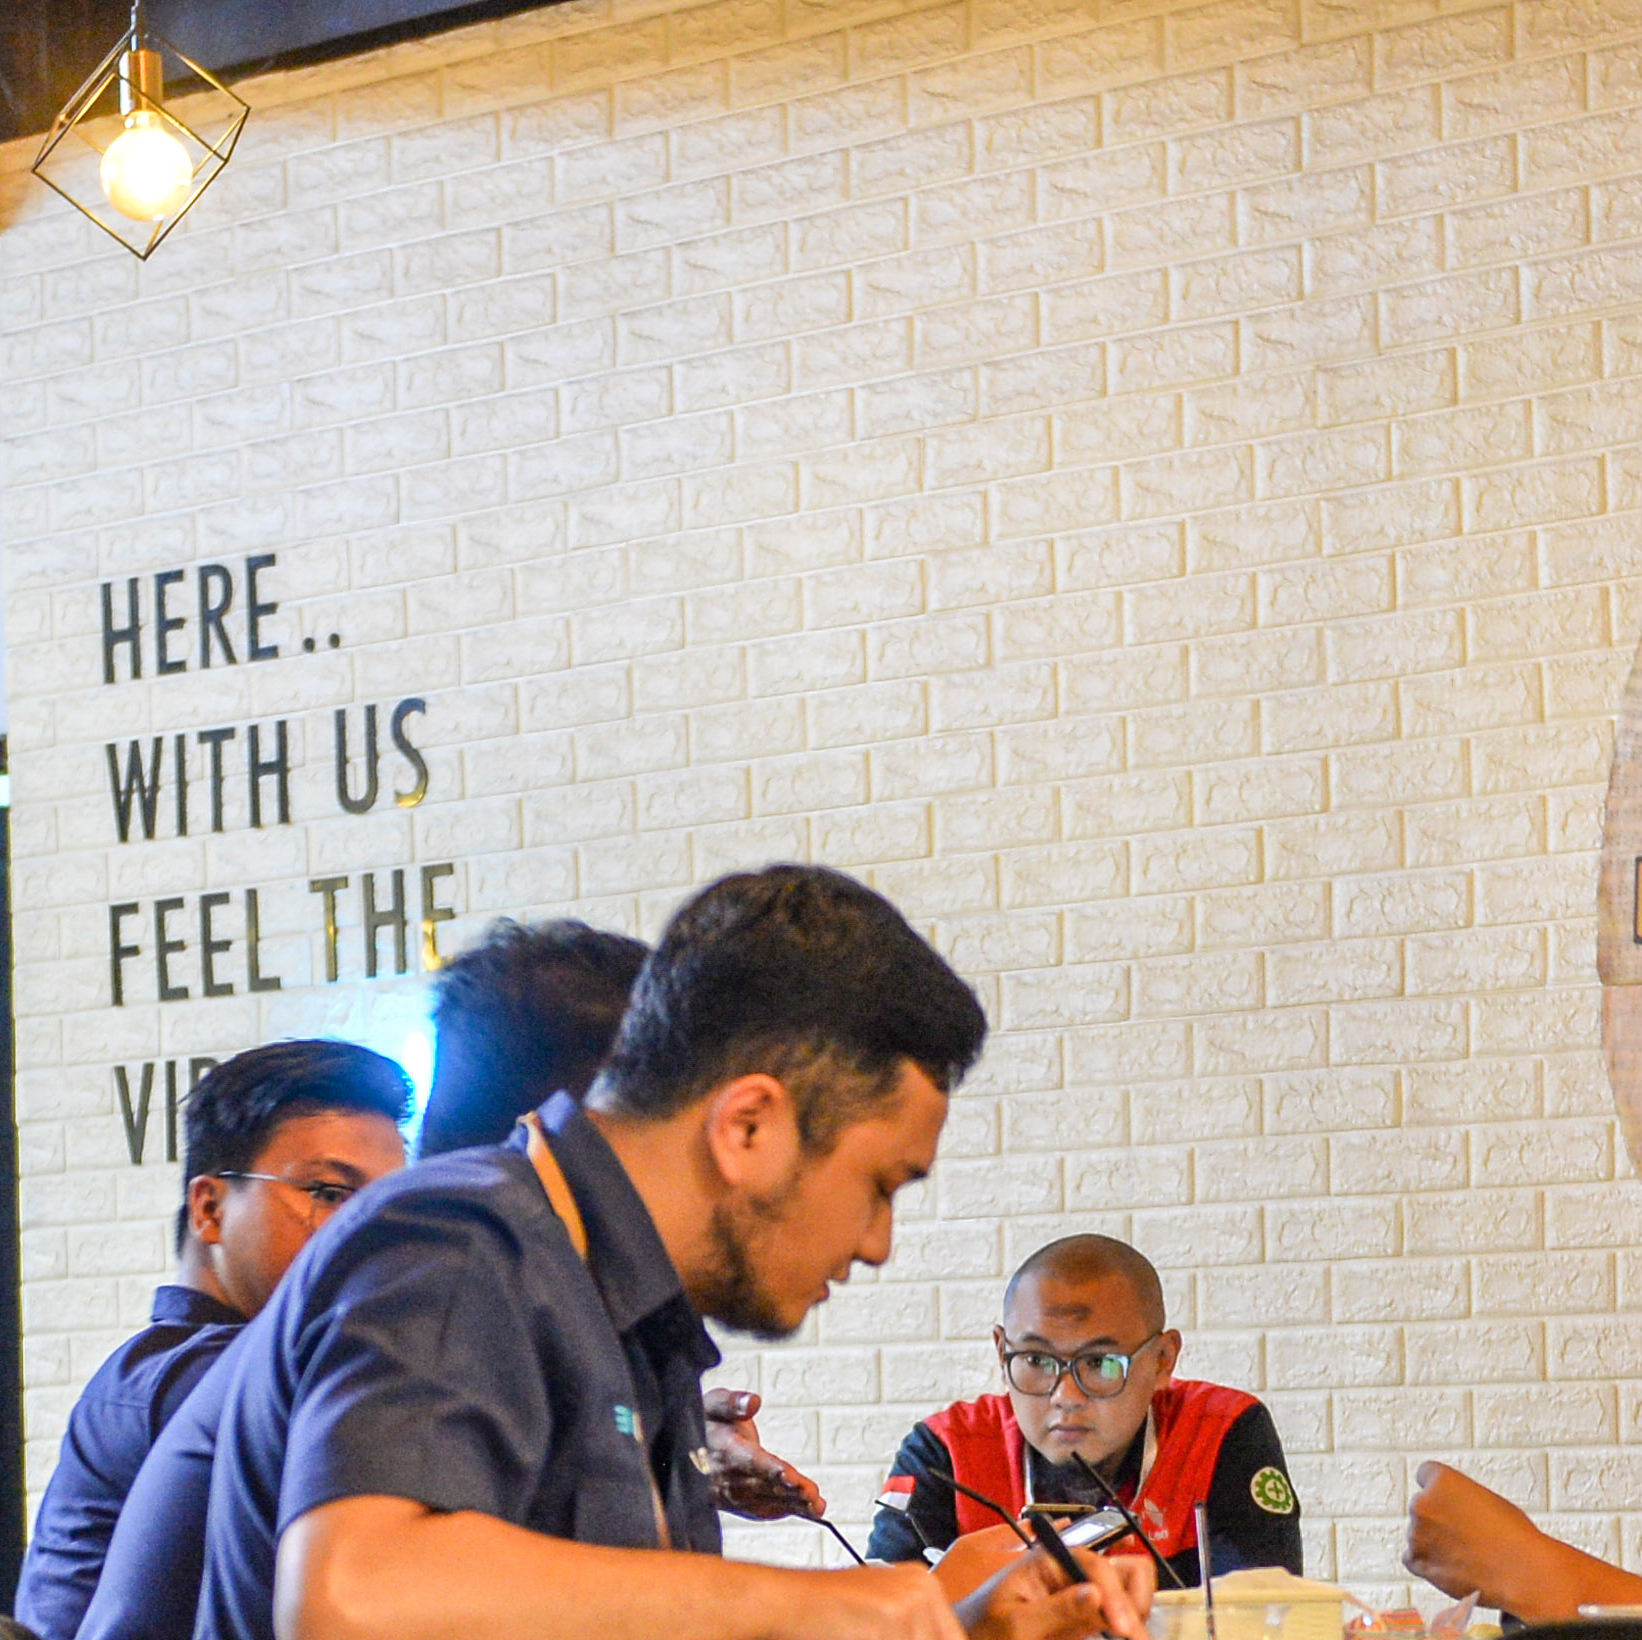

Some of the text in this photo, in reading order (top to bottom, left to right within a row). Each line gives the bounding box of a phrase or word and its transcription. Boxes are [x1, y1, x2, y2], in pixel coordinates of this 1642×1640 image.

[100, 553, 341, 684] HERE..
[105, 697, 429, 844] WITH US
[108, 862, 456, 1007] FEEL THE
